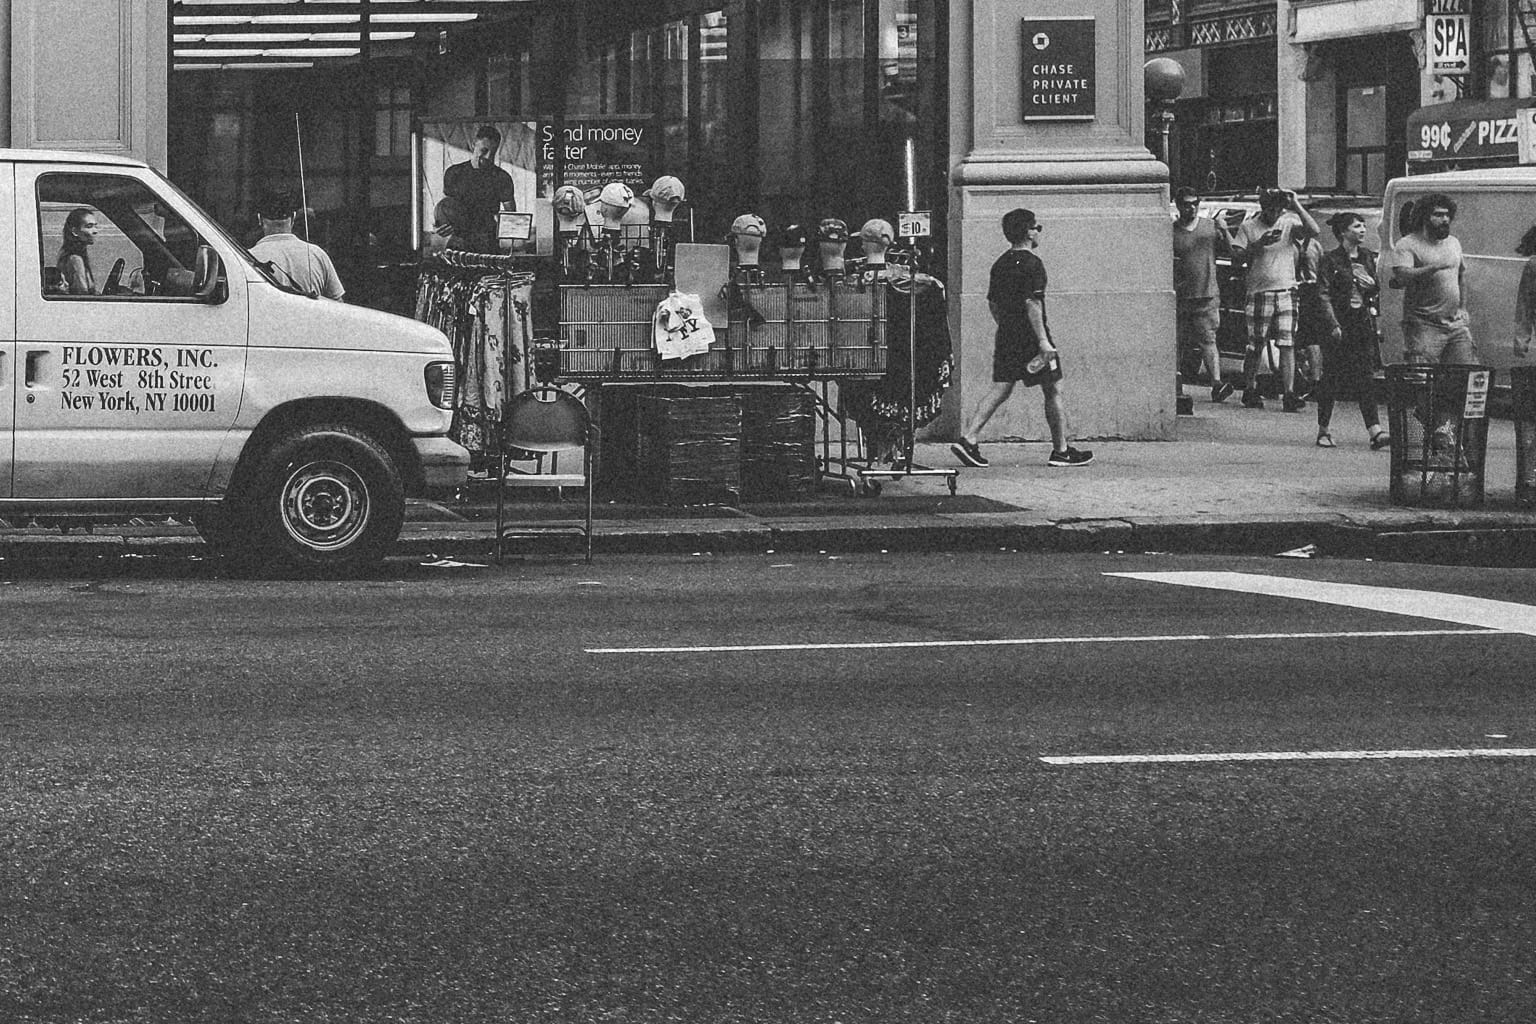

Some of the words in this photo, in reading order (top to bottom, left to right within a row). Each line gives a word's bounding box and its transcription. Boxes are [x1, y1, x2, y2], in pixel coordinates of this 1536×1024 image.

[1434, 18, 1467, 57] SPA
[1032, 64, 1073, 75] CHASE
[1032, 79, 1088, 90] PRIVATE
[1032, 93, 1078, 104] CLIENT
[542, 124, 583, 142] Snd
[588, 127, 643, 146] money
[1421, 121, 1452, 151] 99¢
[1478, 118, 1518, 146] PIZZ
[542, 143, 588, 160] fater
[61, 346, 169, 371] FLOWERS,
[176, 348, 218, 368] INC.
[62, 368, 81, 388] 52
[86, 369, 124, 388] West
[137, 369, 165, 389] 8th
[61, 391, 94, 410] New
[98, 390, 140, 415] York,
[145, 392, 167, 412] NY
[172, 393, 216, 412] 10001
